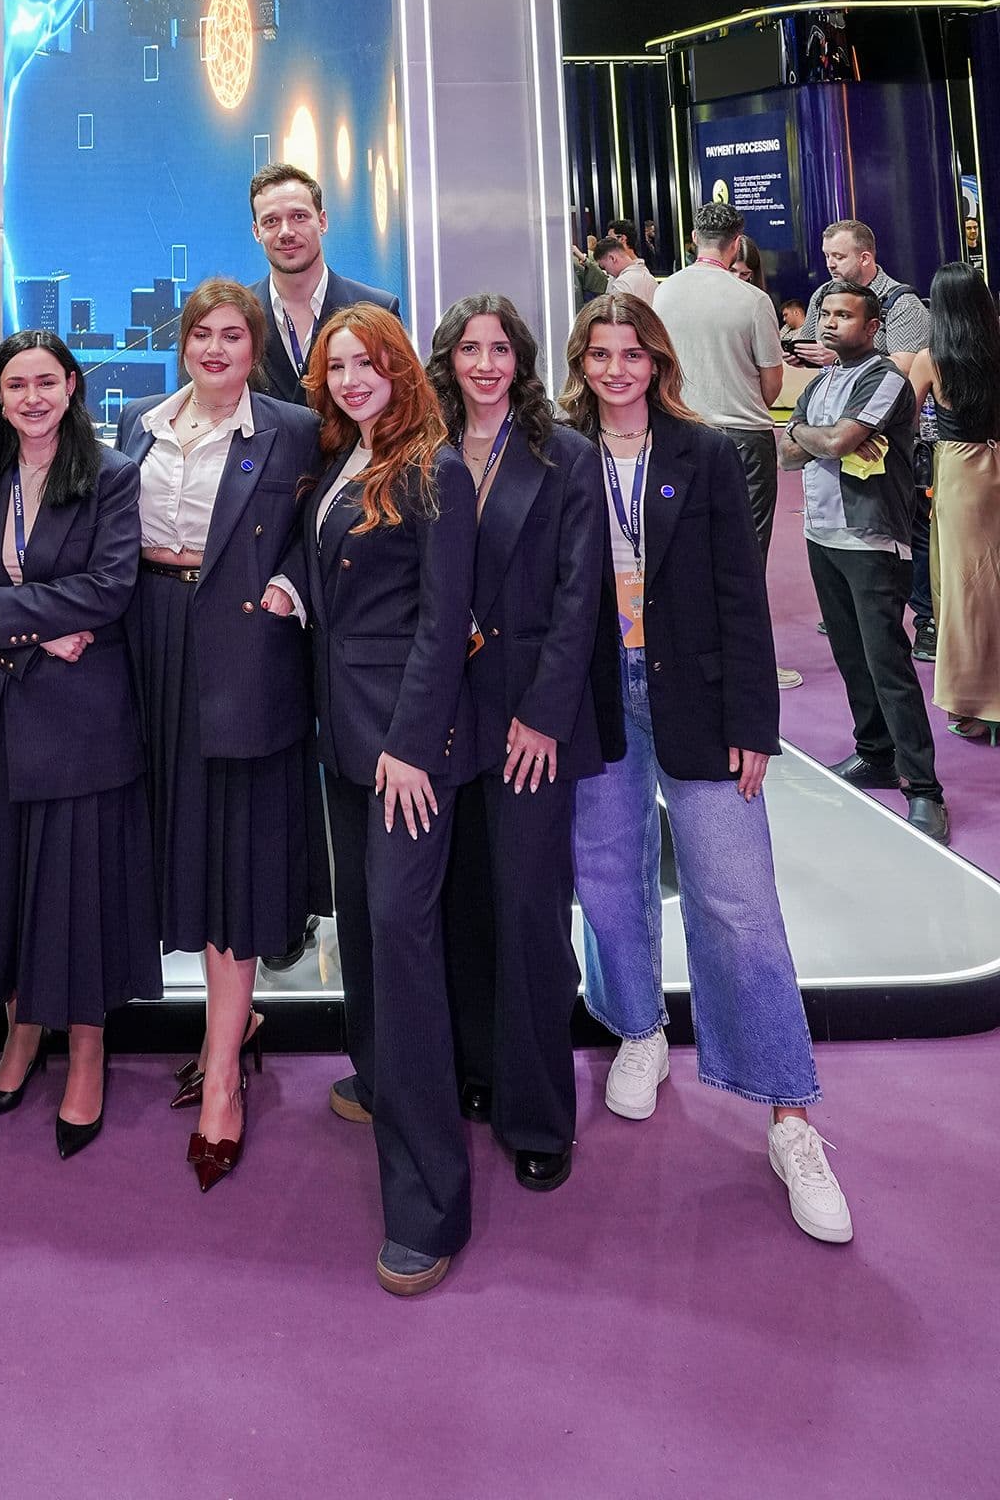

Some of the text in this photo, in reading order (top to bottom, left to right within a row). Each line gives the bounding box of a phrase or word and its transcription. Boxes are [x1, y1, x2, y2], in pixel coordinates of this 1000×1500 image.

[705, 138, 780, 158] PAYMENT PROCESSING
[606, 457, 618, 489] DIGITAIN
[14, 484, 22, 516] DIGITAIN
